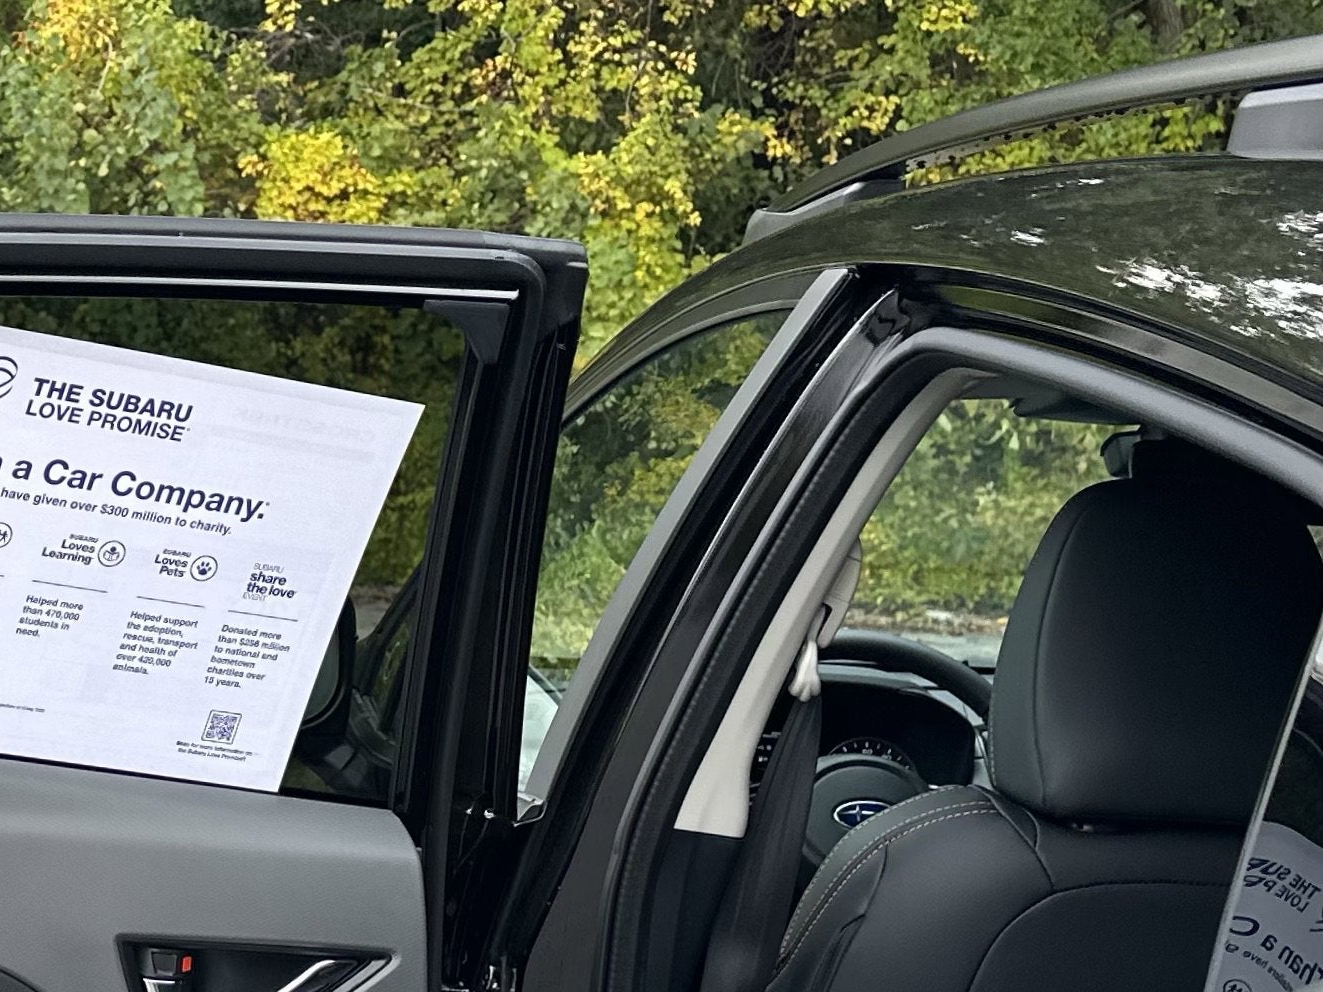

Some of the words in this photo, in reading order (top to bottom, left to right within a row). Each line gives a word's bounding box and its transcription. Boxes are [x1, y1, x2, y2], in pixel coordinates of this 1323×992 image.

[34, 377, 84, 403] THE
[89, 388, 193, 422] SUBARU
[25, 399, 84, 424] LOVE
[12, 460, 32, 480] a
[43, 459, 103, 491] Car
[0, 487, 30, 501] have
[32, 493, 67, 507] given
[70, 501, 98, 512] over
[100, 504, 129, 517] $300
[131, 511, 171, 524] million
[174, 516, 186, 527] to
[189, 519, 231, 536] charity.
[61, 539, 95, 553] Loves
[154, 554, 188, 567] Loves
[250, 571, 286, 585] share
[246, 582, 267, 594] the
[26, 595, 58, 606] Helped
[59, 601, 83, 610] more
[23, 605, 43, 615] than
[18, 616, 58, 628] students
[60, 622, 69, 630] in
[126, 621, 141, 630] the
[130, 611, 162, 622] Helped
[163, 617, 198, 628] support
[221, 624, 258, 636] Donated
[259, 631, 281, 640] more
[123, 633, 154, 644] rescue,
[157, 637, 198, 649] transport
[217, 635, 237, 644] than
[119, 643, 137, 651] and
[138, 644, 166, 655] health
[214, 645, 223, 653] to
[225, 648, 260, 658] national
[261, 653, 278, 661] and
[245, 672, 265, 680] over
